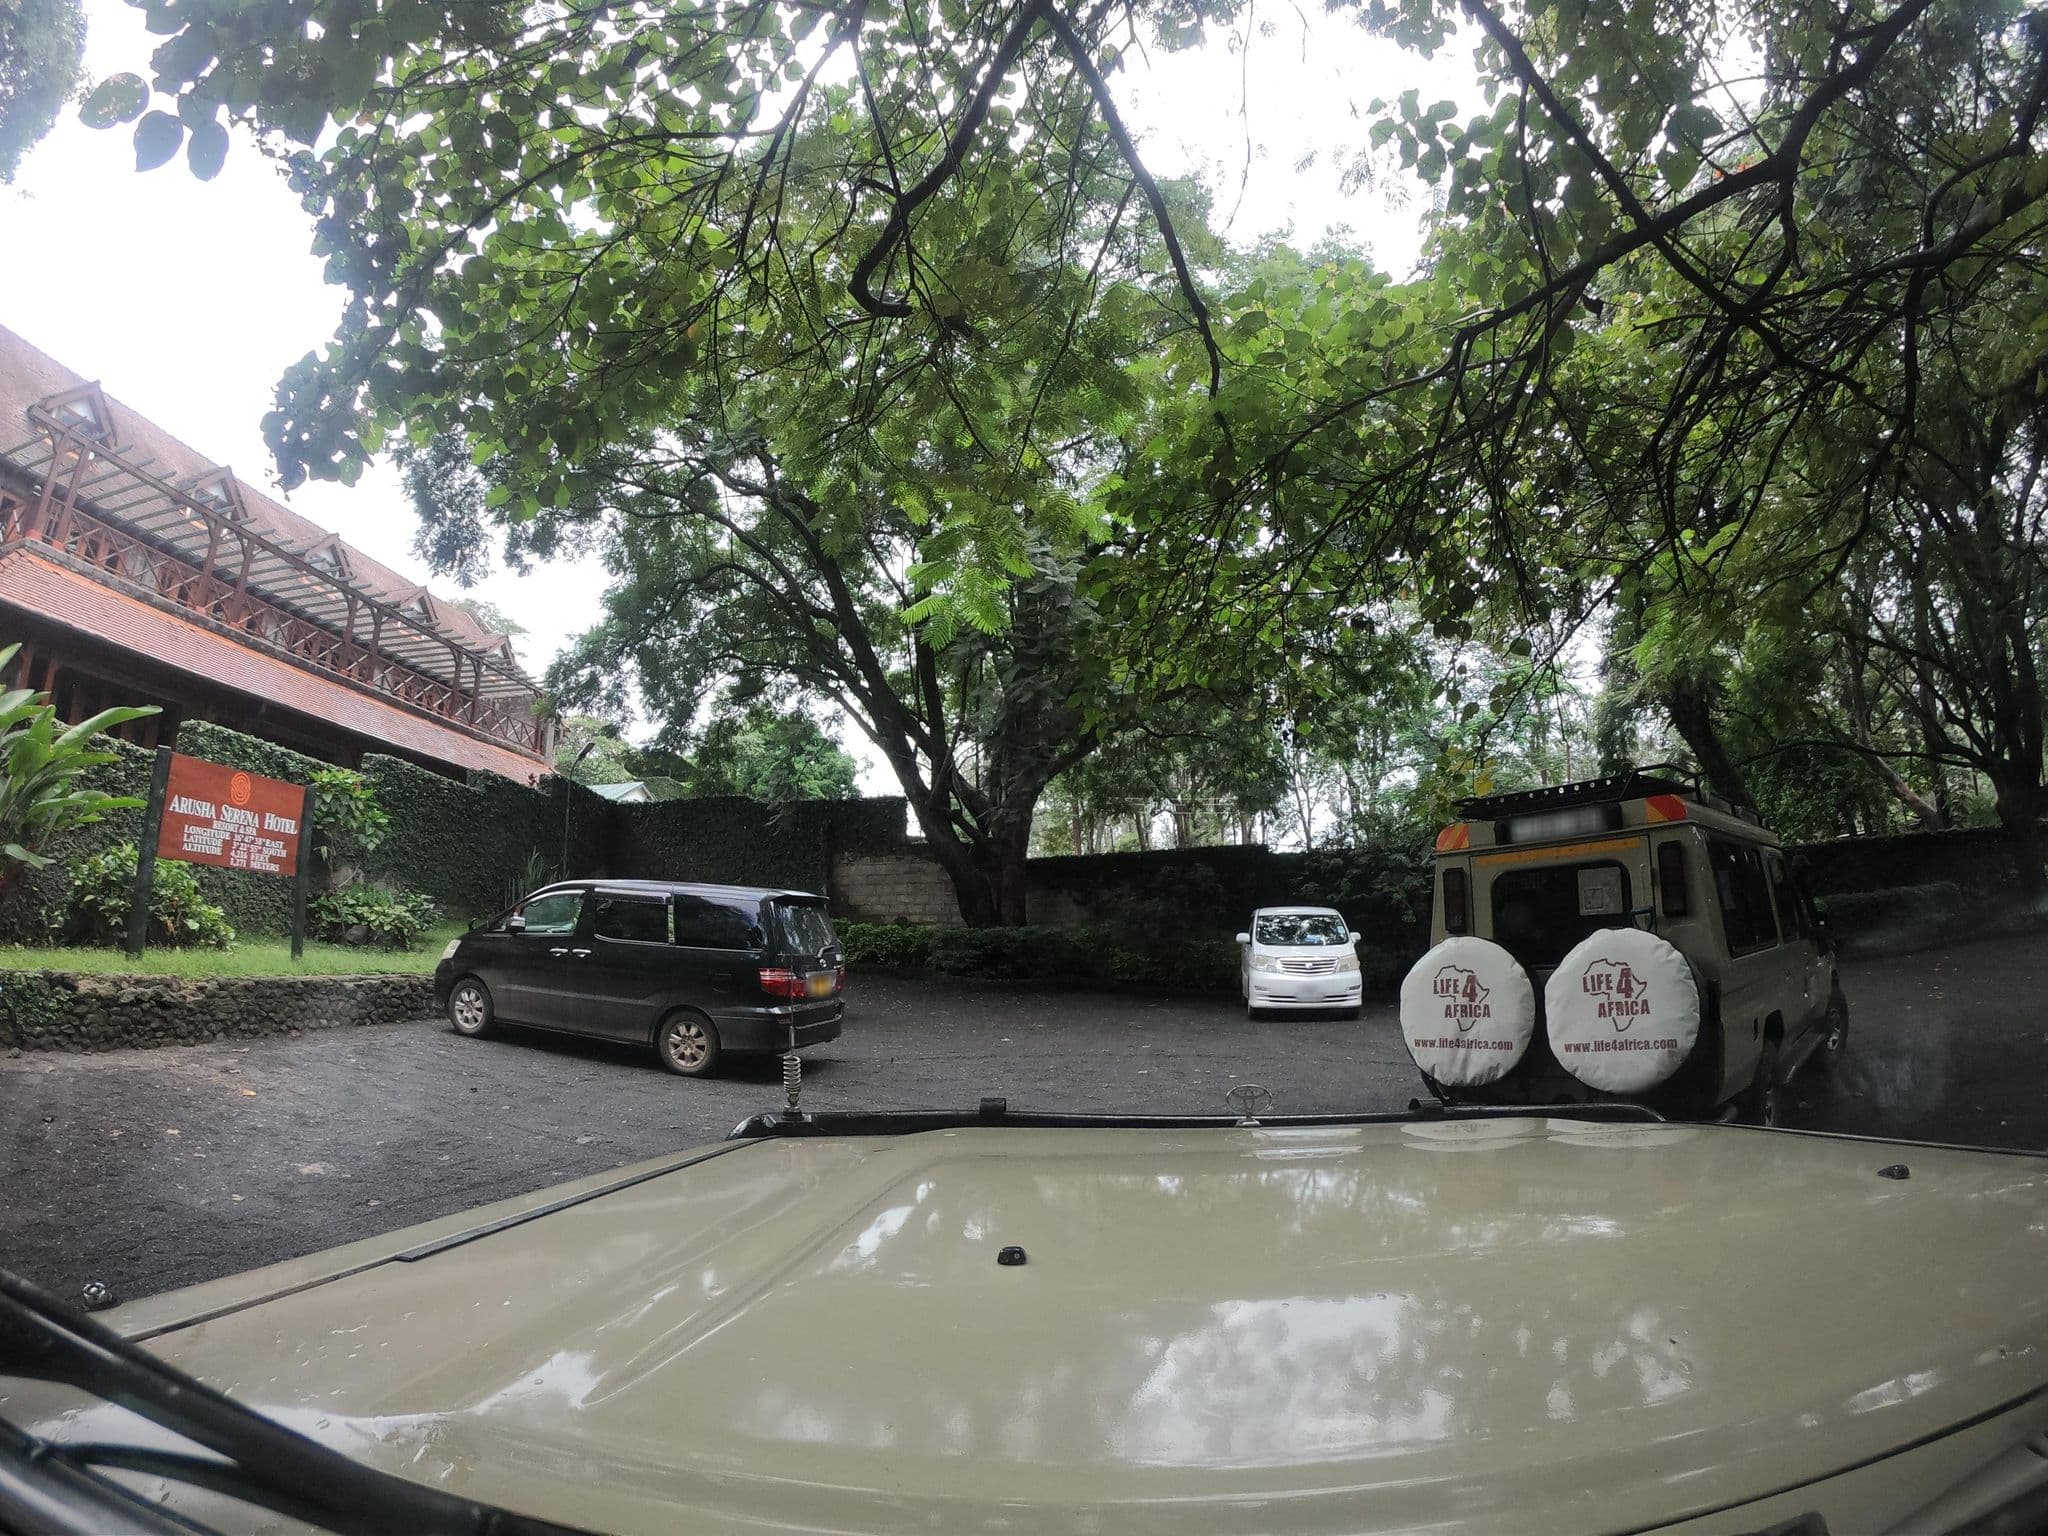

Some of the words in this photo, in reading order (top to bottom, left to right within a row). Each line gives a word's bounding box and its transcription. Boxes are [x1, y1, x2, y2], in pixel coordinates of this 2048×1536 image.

[169, 794, 216, 819] ARUSHA
[220, 804, 259, 828] SERENA
[264, 812, 297, 835] HOTEL
[184, 824, 231, 840] LONGITUDE
[212, 820, 239, 832] RESORT
[182, 843, 223, 856] ALTITUDE
[250, 852, 271, 862] FEET
[183, 834, 224, 847] LATITUDE
[262, 846, 287, 857] SOUTH
[250, 860, 281, 872] METERS
[1433, 978, 1460, 994] LIFE
[1462, 974, 1477, 1002] 4
[1582, 973, 1613, 993] LIFE
[1616, 967, 1633, 998] 4
[1444, 1003, 1491, 1018] AFRICA
[1598, 999, 1650, 1018] AFRICA
[1414, 1037, 1513, 1050] www.life4africa.com
[1564, 1038, 1678, 1053] www.life4africa.com
